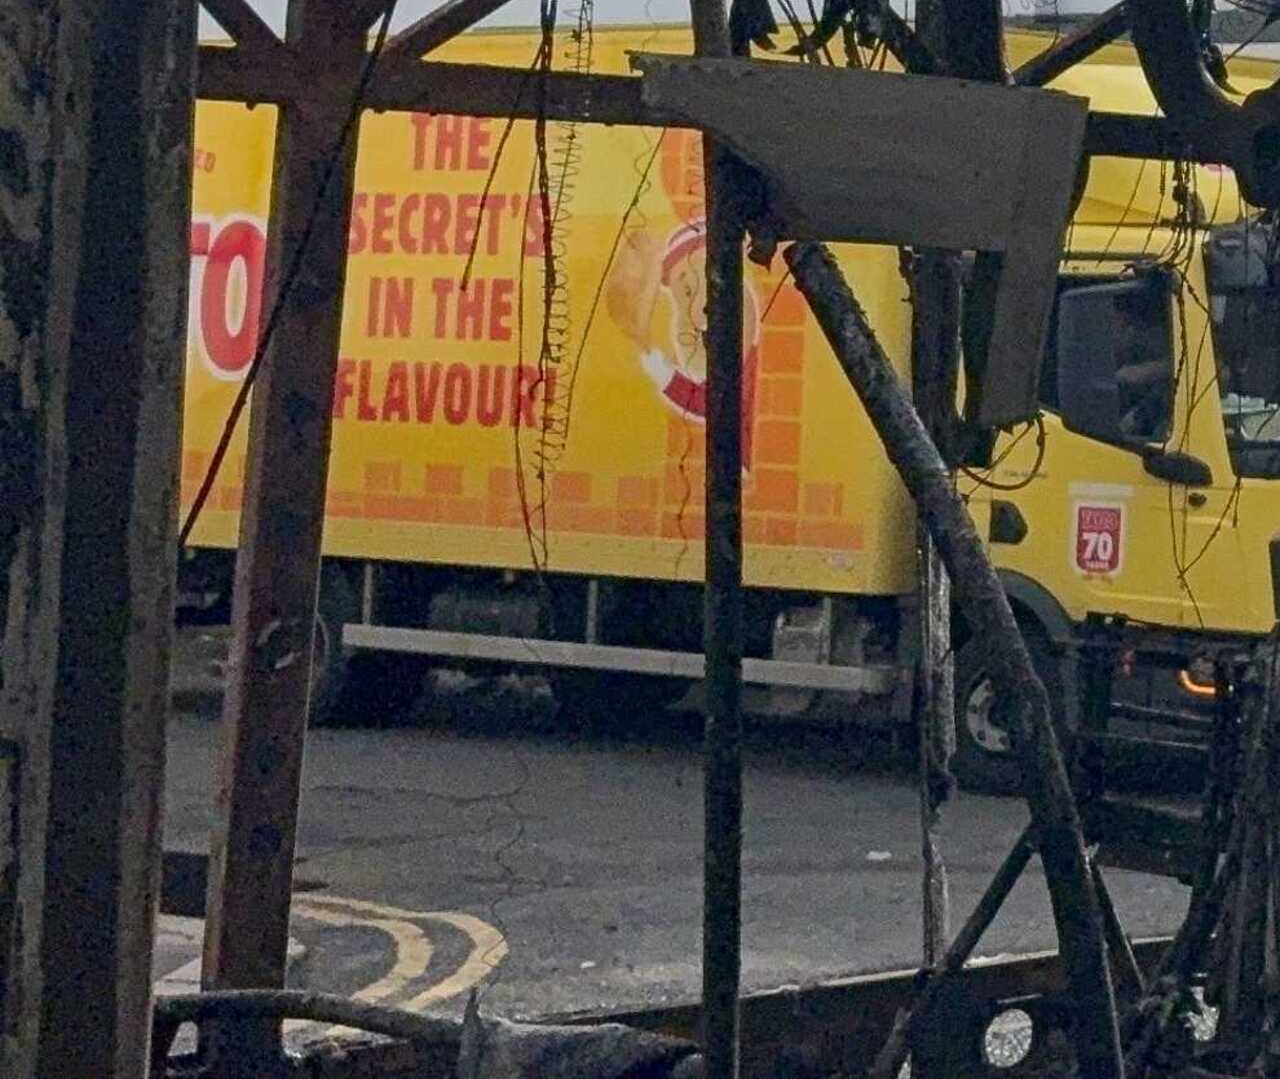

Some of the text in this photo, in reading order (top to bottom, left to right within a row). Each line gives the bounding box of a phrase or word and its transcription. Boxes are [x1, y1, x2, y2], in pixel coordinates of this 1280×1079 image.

[410, 111, 491, 170] THE
[347, 192, 550, 257] SECRET'S
[367, 276, 514, 341] IN THE
[1082, 531, 1113, 562] 70
